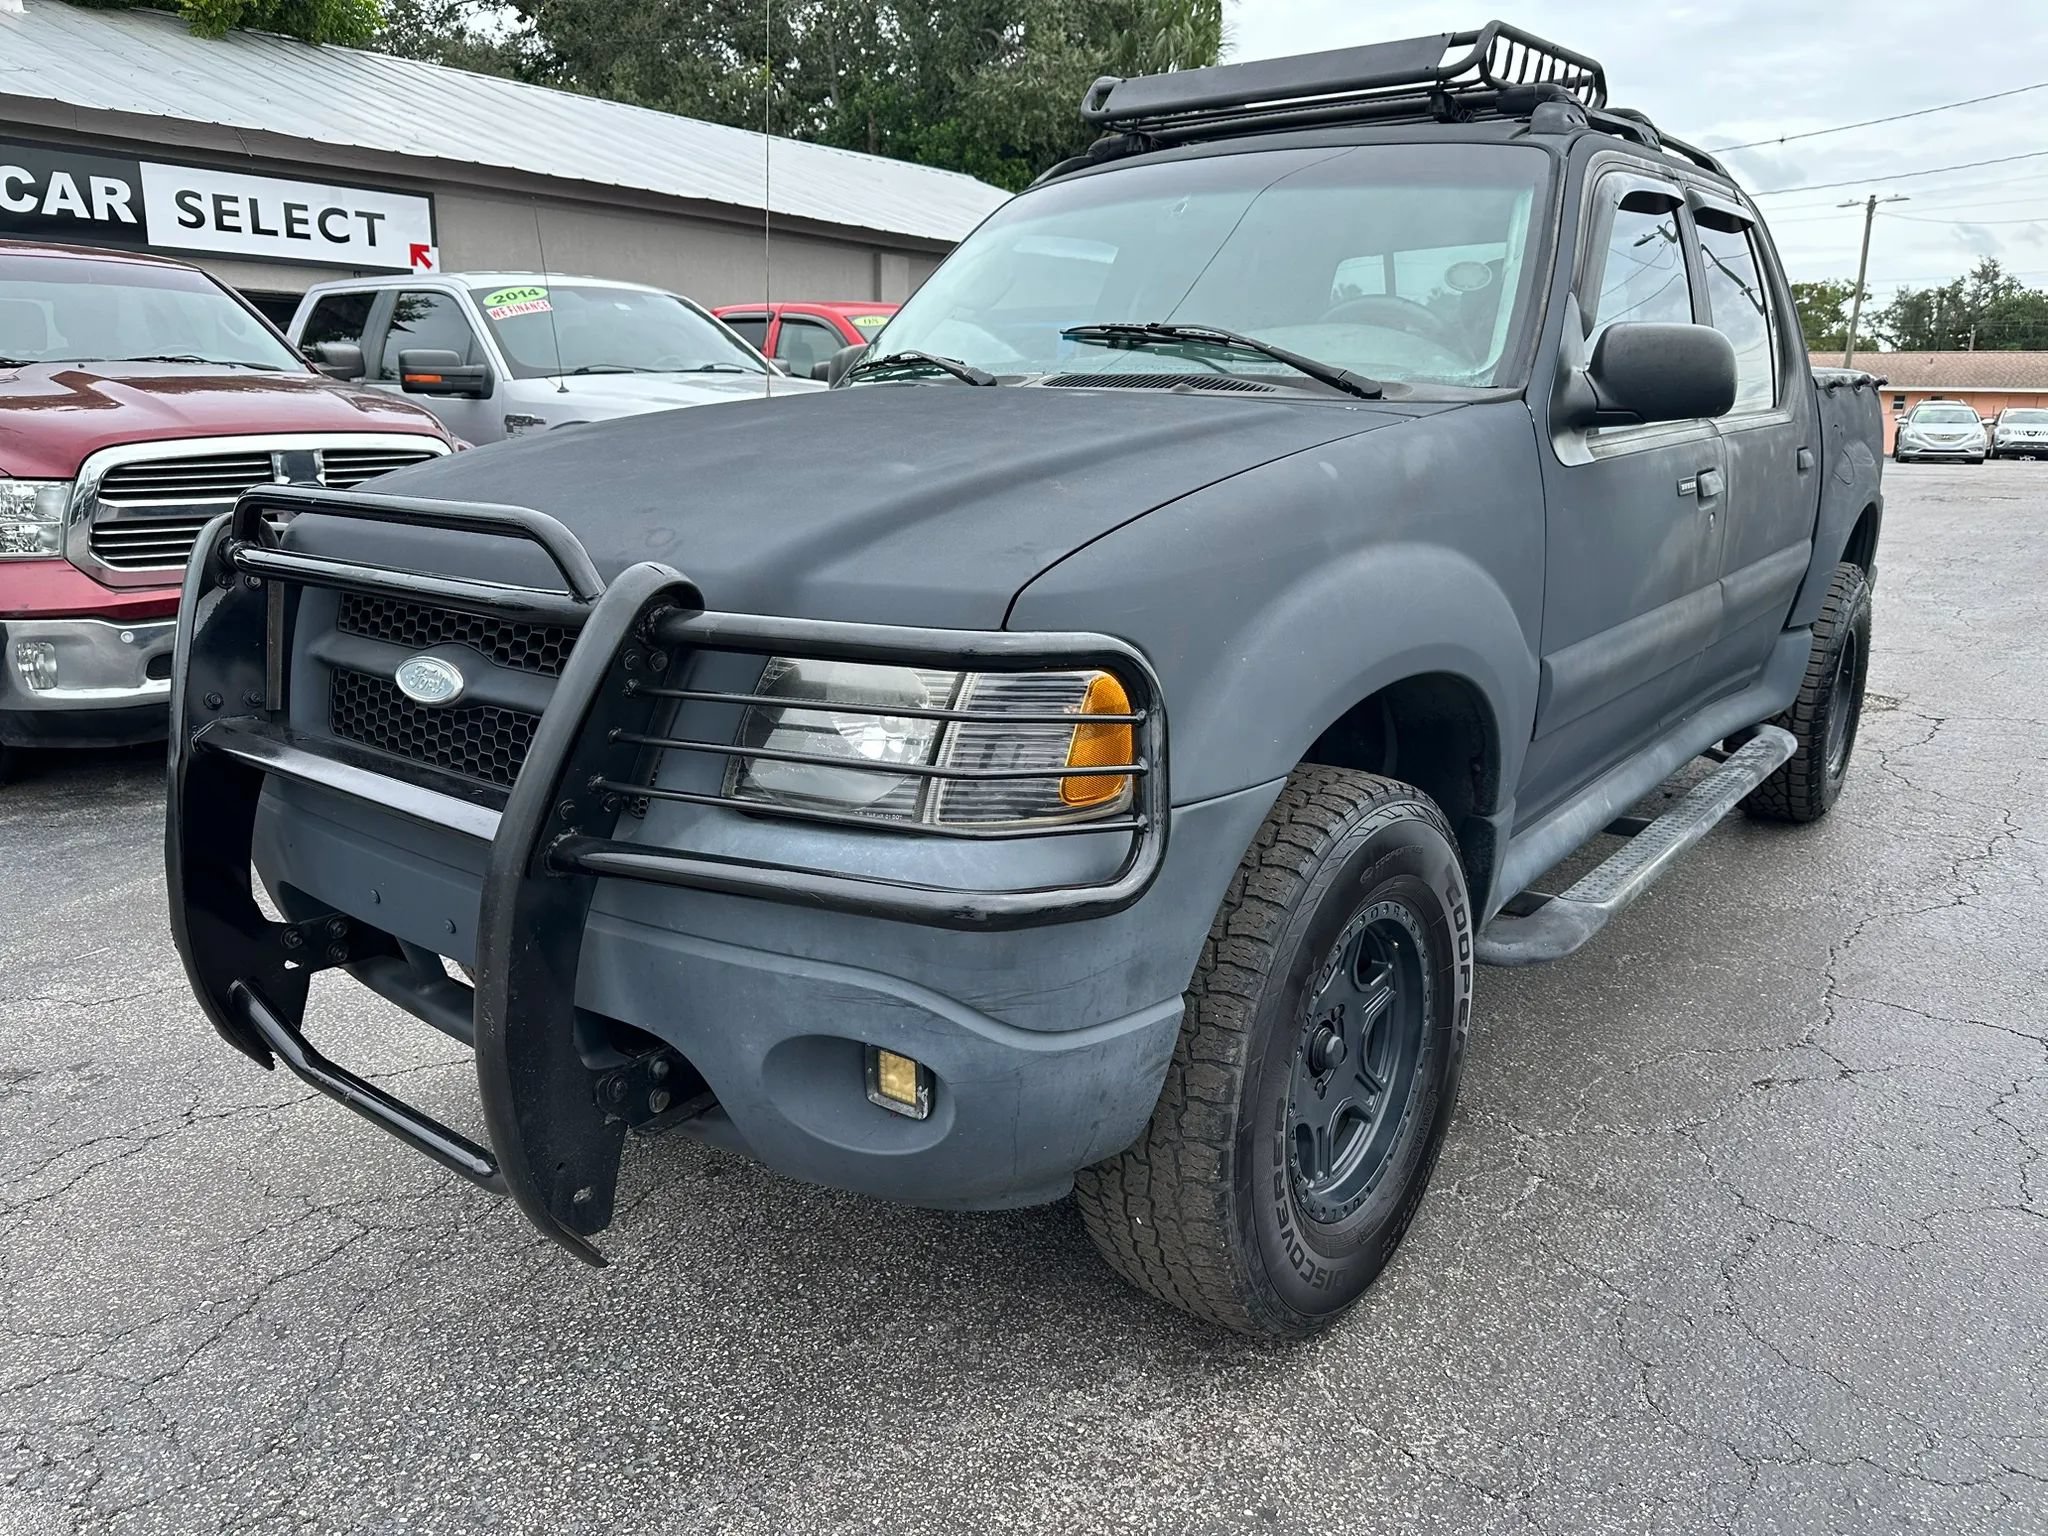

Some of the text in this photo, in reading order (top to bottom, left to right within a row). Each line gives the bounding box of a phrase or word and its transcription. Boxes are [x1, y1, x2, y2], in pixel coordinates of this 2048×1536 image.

[0, 165, 386, 247] CAR SELECT
[491, 302, 548, 318] WE FINANCE
[493, 289, 540, 304] 2014
[408, 665, 446, 694] Ford
[1273, 1096, 1348, 1291] DISCOVERER
